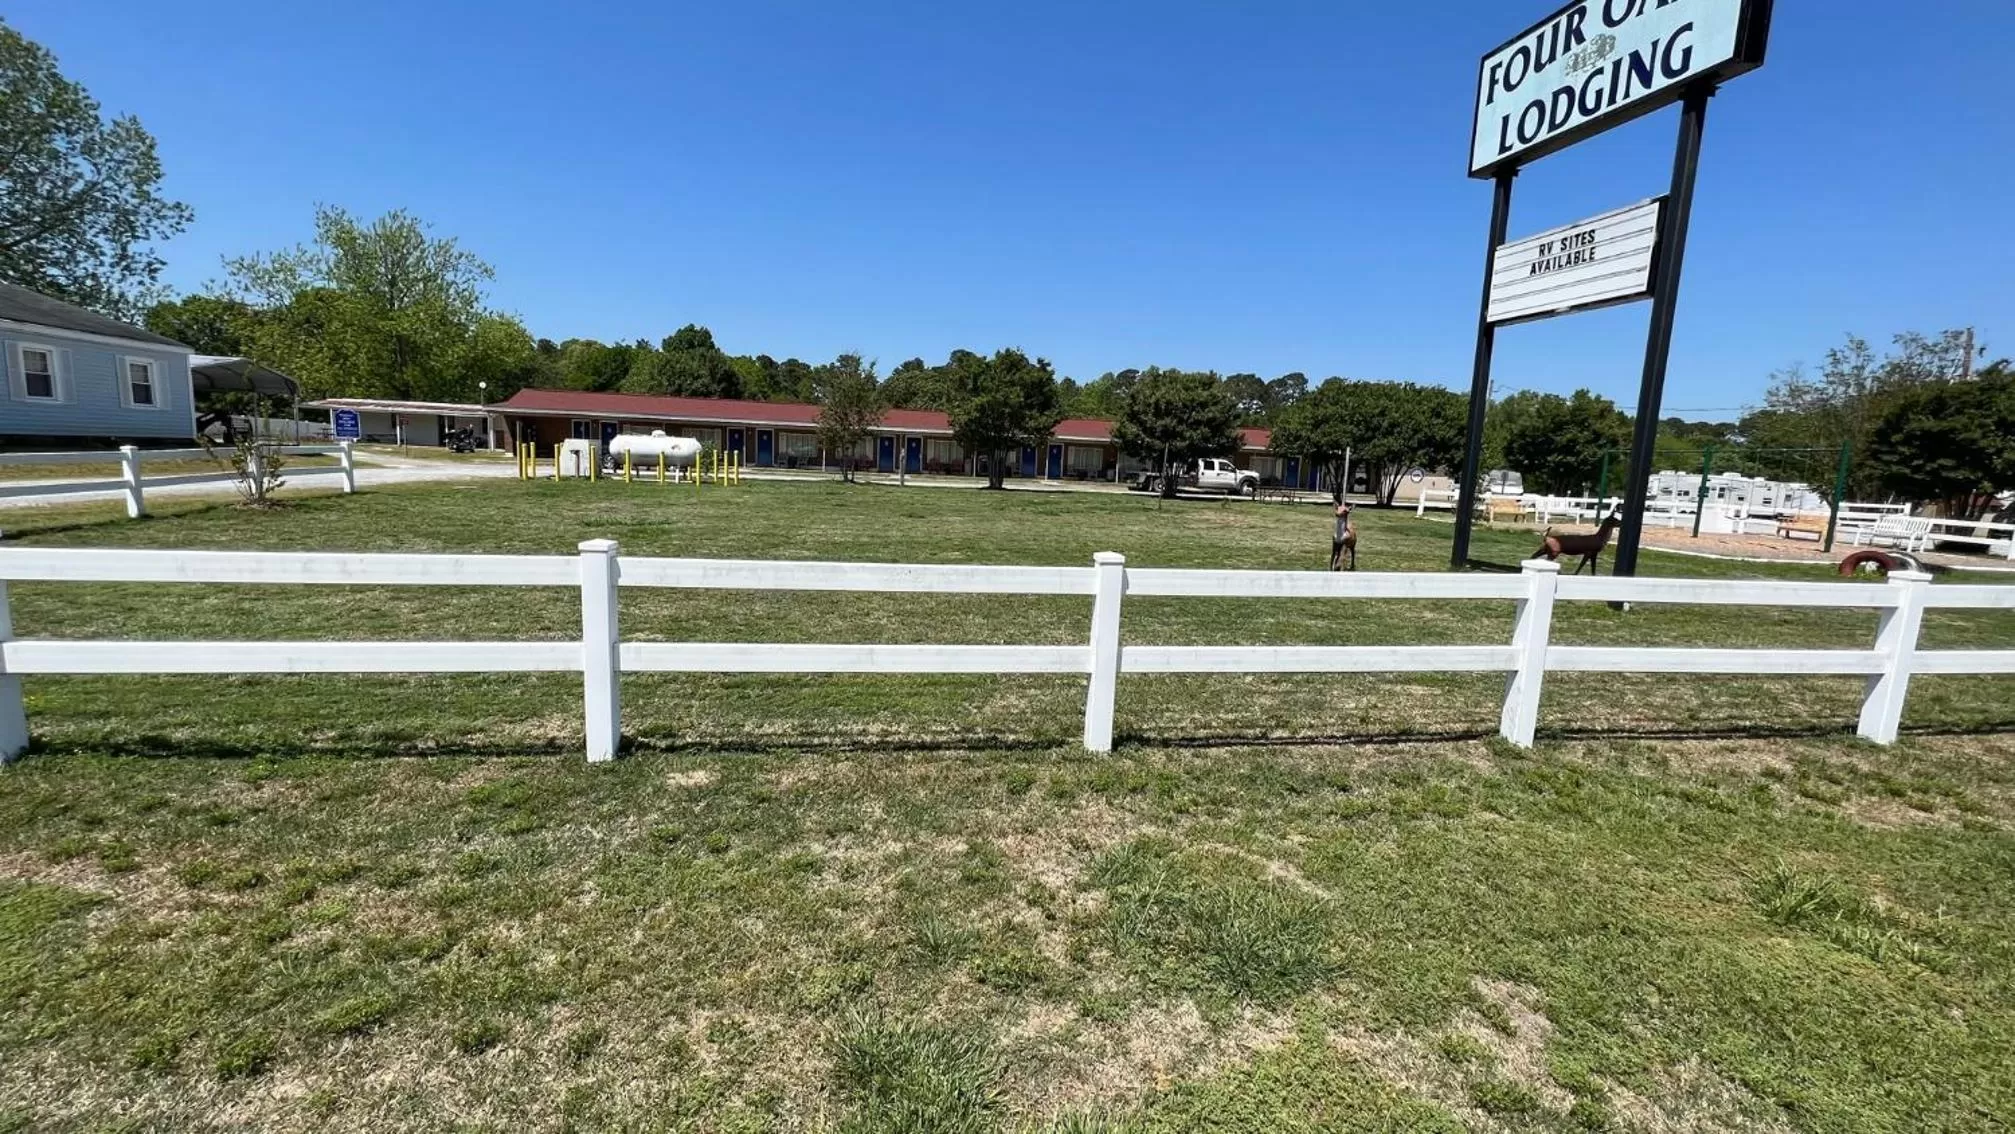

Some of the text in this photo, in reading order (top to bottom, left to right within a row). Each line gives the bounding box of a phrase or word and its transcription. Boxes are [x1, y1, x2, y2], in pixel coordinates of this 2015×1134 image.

[1485, 5, 1588, 106] FOUR
[1497, 21, 1694, 156] LODGING
[1529, 246, 1597, 276] AVAILABLE
[1539, 229, 1596, 257] RV SITES
